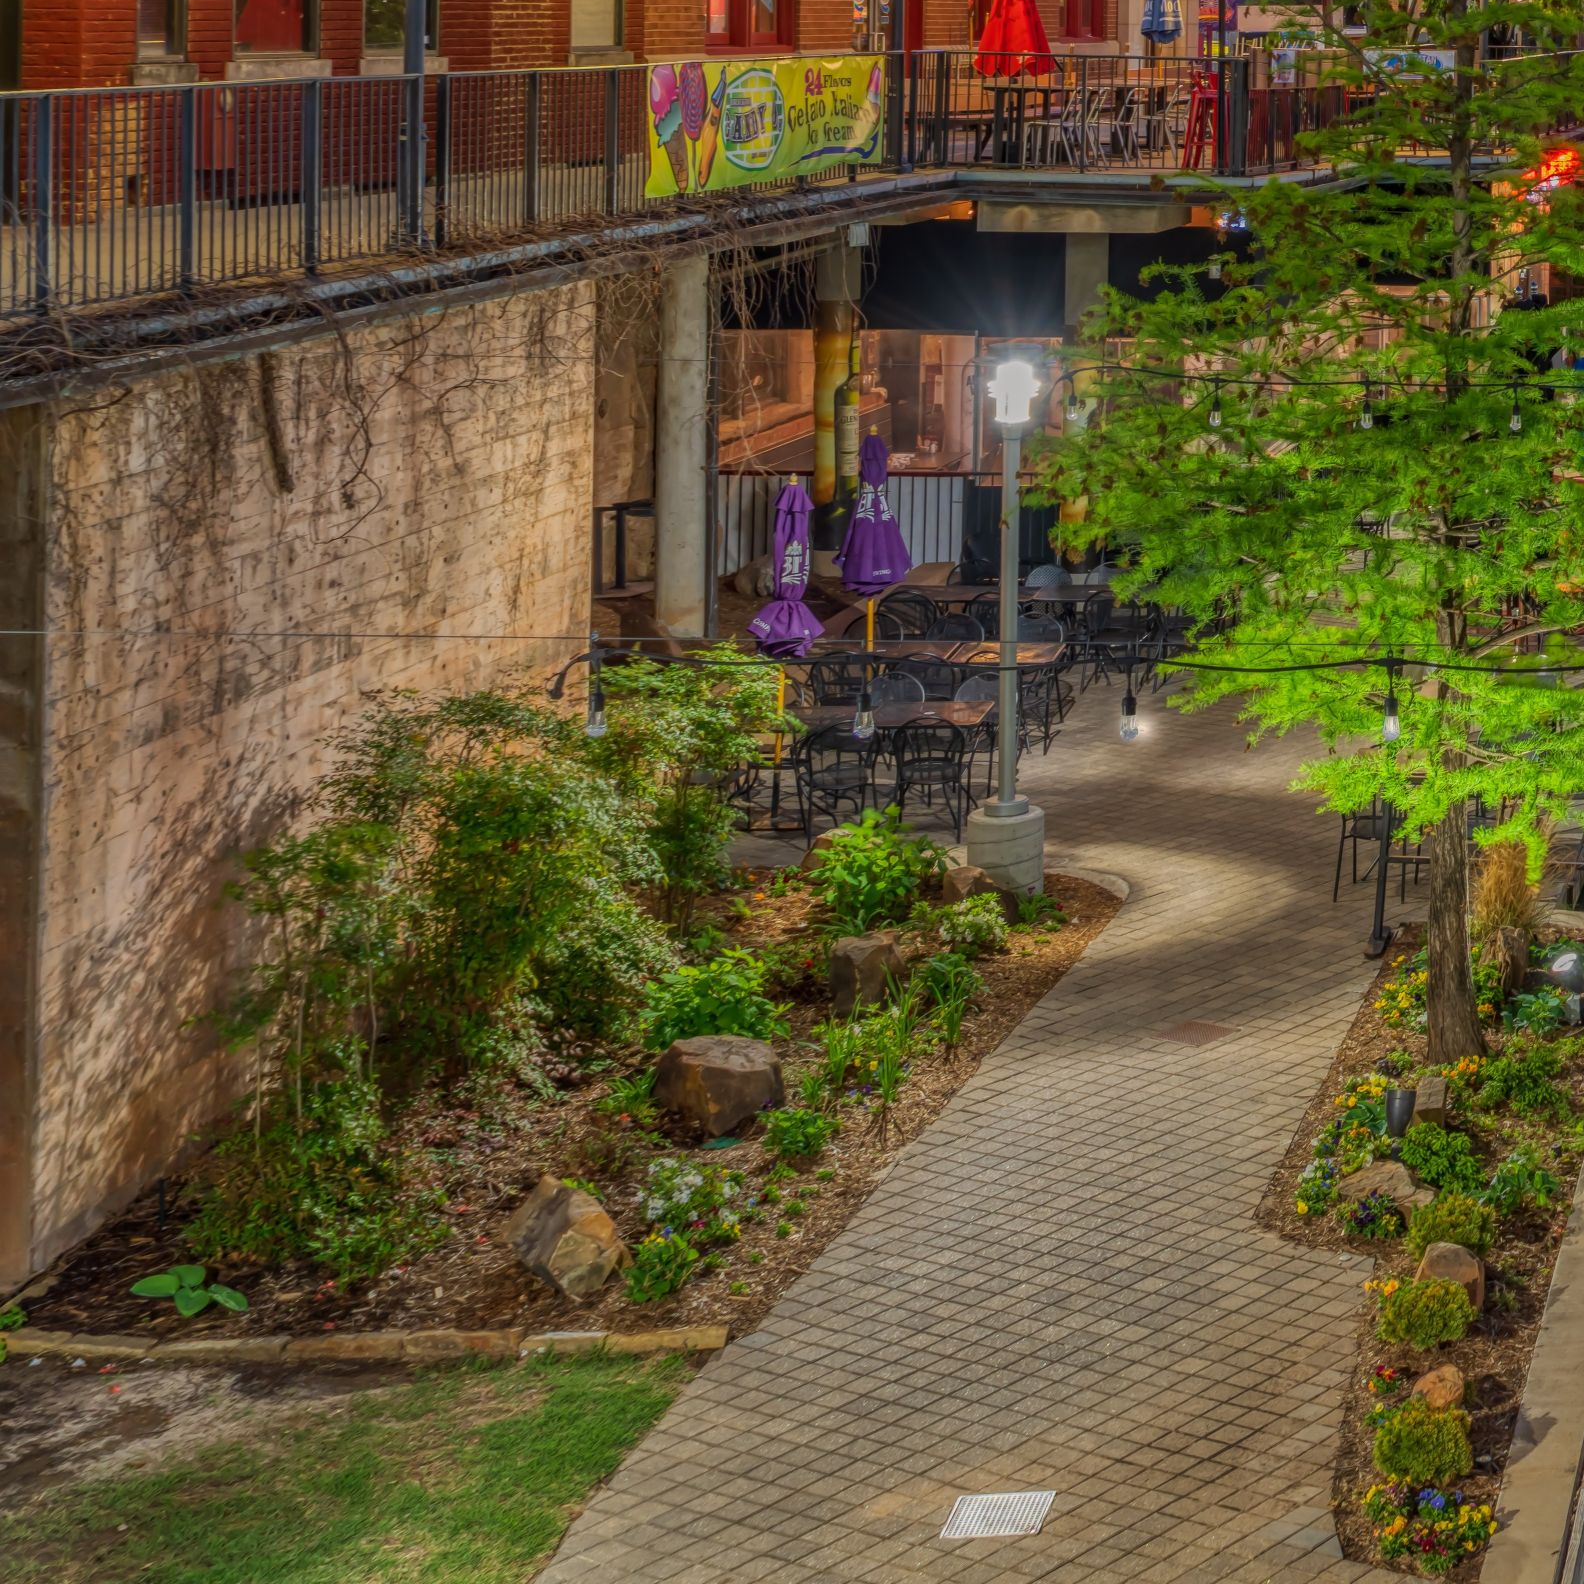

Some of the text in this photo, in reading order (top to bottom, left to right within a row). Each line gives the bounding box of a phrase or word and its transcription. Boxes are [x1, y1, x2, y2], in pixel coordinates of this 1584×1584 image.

[804, 67, 824, 96] 24
[787, 96, 826, 133] Gelato
[823, 122, 856, 144] Cream
